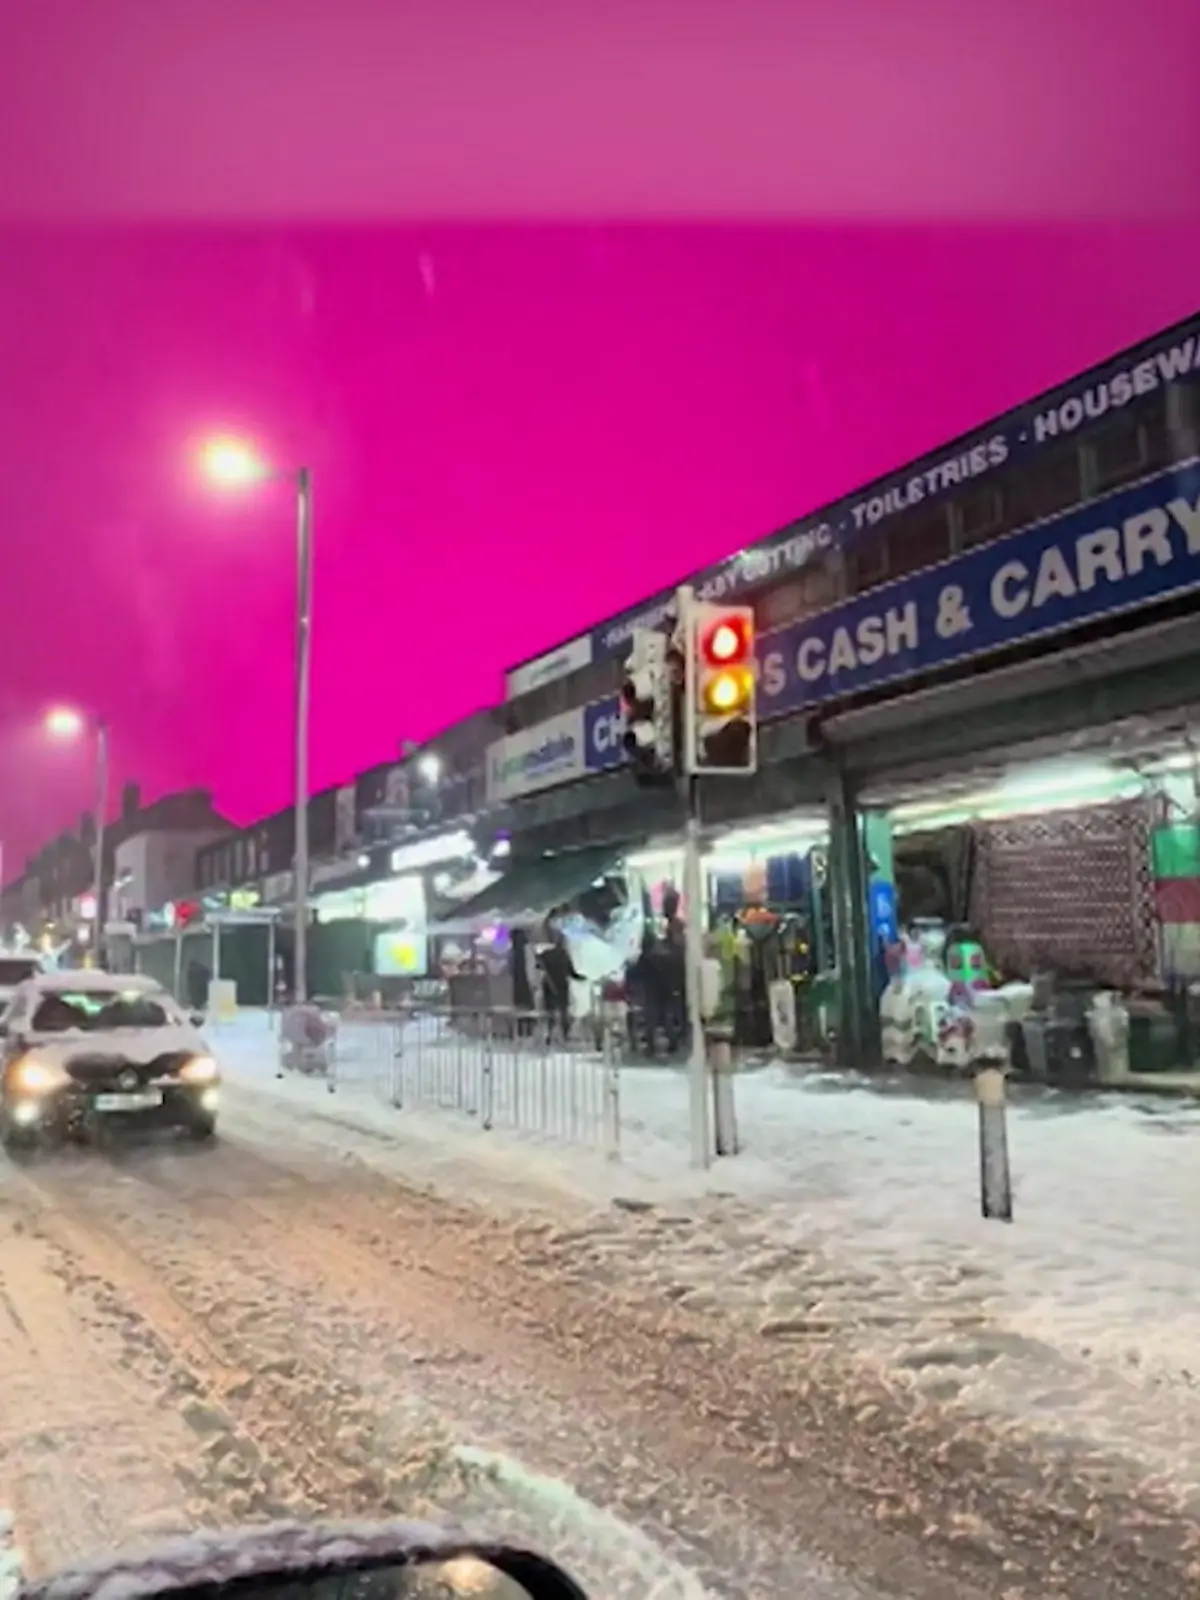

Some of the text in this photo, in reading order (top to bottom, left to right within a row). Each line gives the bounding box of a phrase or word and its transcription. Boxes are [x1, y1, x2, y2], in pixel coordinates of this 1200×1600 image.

[851, 434, 1009, 529] TOILETRIES
[797, 601, 918, 681] CASH
[935, 585, 974, 638] &
[990, 496, 1200, 618] CARRY
